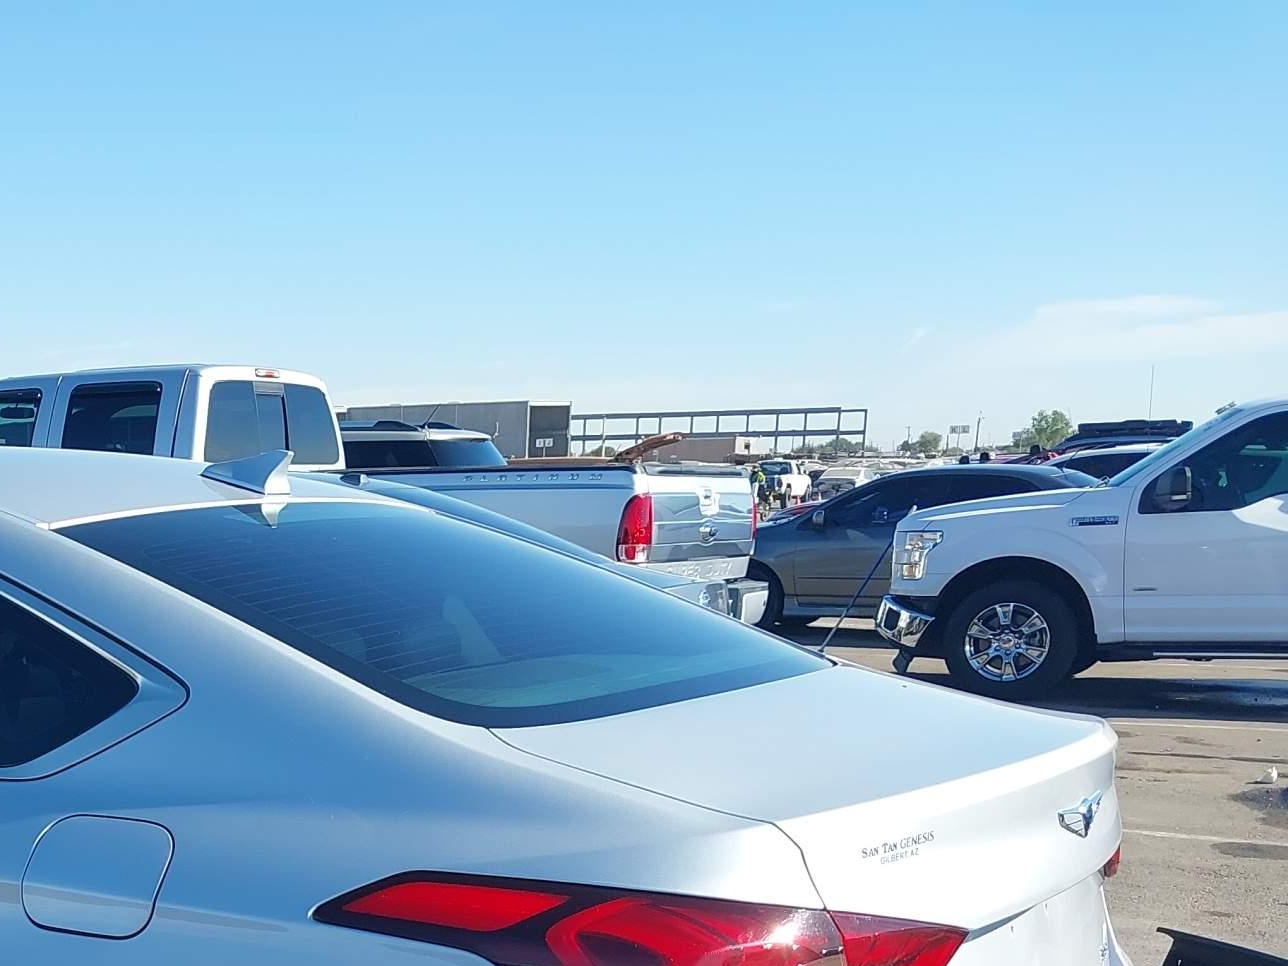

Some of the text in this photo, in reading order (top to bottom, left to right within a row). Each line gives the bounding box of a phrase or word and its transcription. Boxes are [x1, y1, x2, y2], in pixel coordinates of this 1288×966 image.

[462, 473, 603, 482] PLATINUM
[861, 830, 935, 859] SAN TAN GENESIS
